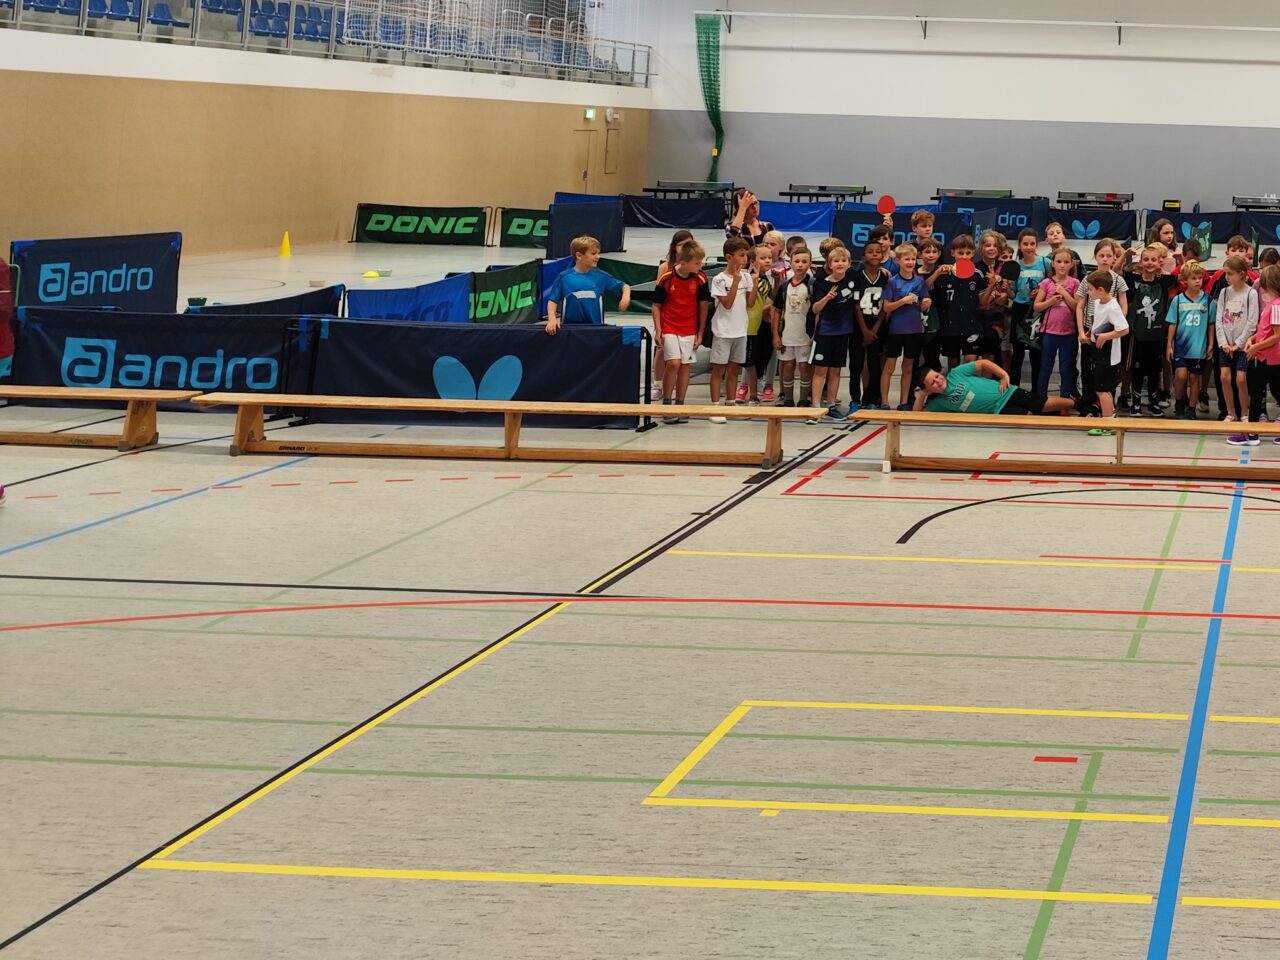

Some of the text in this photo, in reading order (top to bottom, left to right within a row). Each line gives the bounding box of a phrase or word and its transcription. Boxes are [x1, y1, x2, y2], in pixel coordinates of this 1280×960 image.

[365, 213, 479, 234] DONIC
[998, 211, 1027, 227] dro
[70, 263, 154, 296] andro
[1185, 314, 1201, 327] 23
[118, 348, 279, 390] andro
